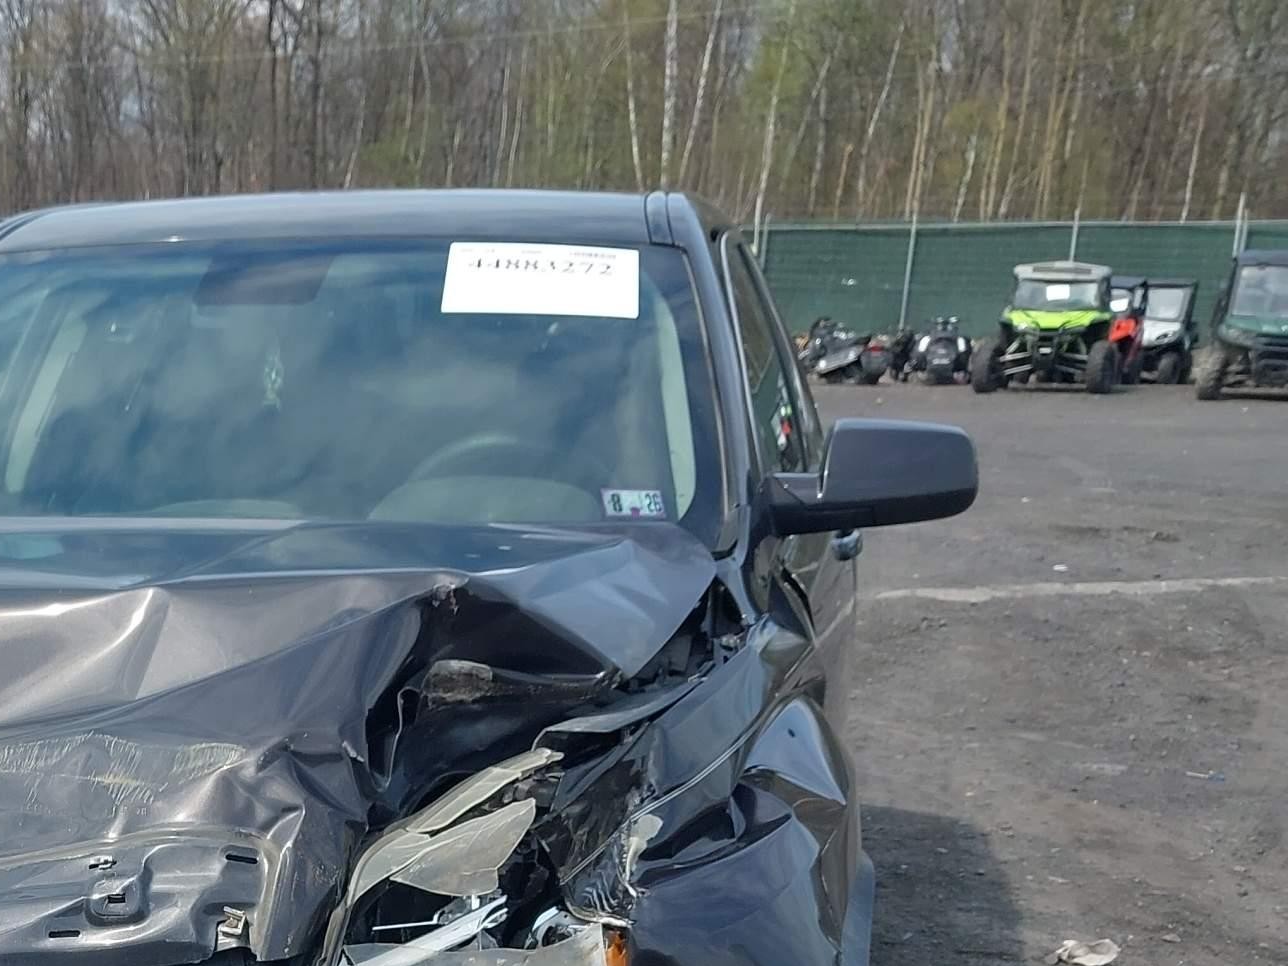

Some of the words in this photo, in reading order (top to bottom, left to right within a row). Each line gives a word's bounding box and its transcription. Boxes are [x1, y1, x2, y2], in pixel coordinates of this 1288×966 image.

[468, 257, 614, 277] 44883272
[610, 493, 623, 512] 8
[644, 492, 663, 513] 26
